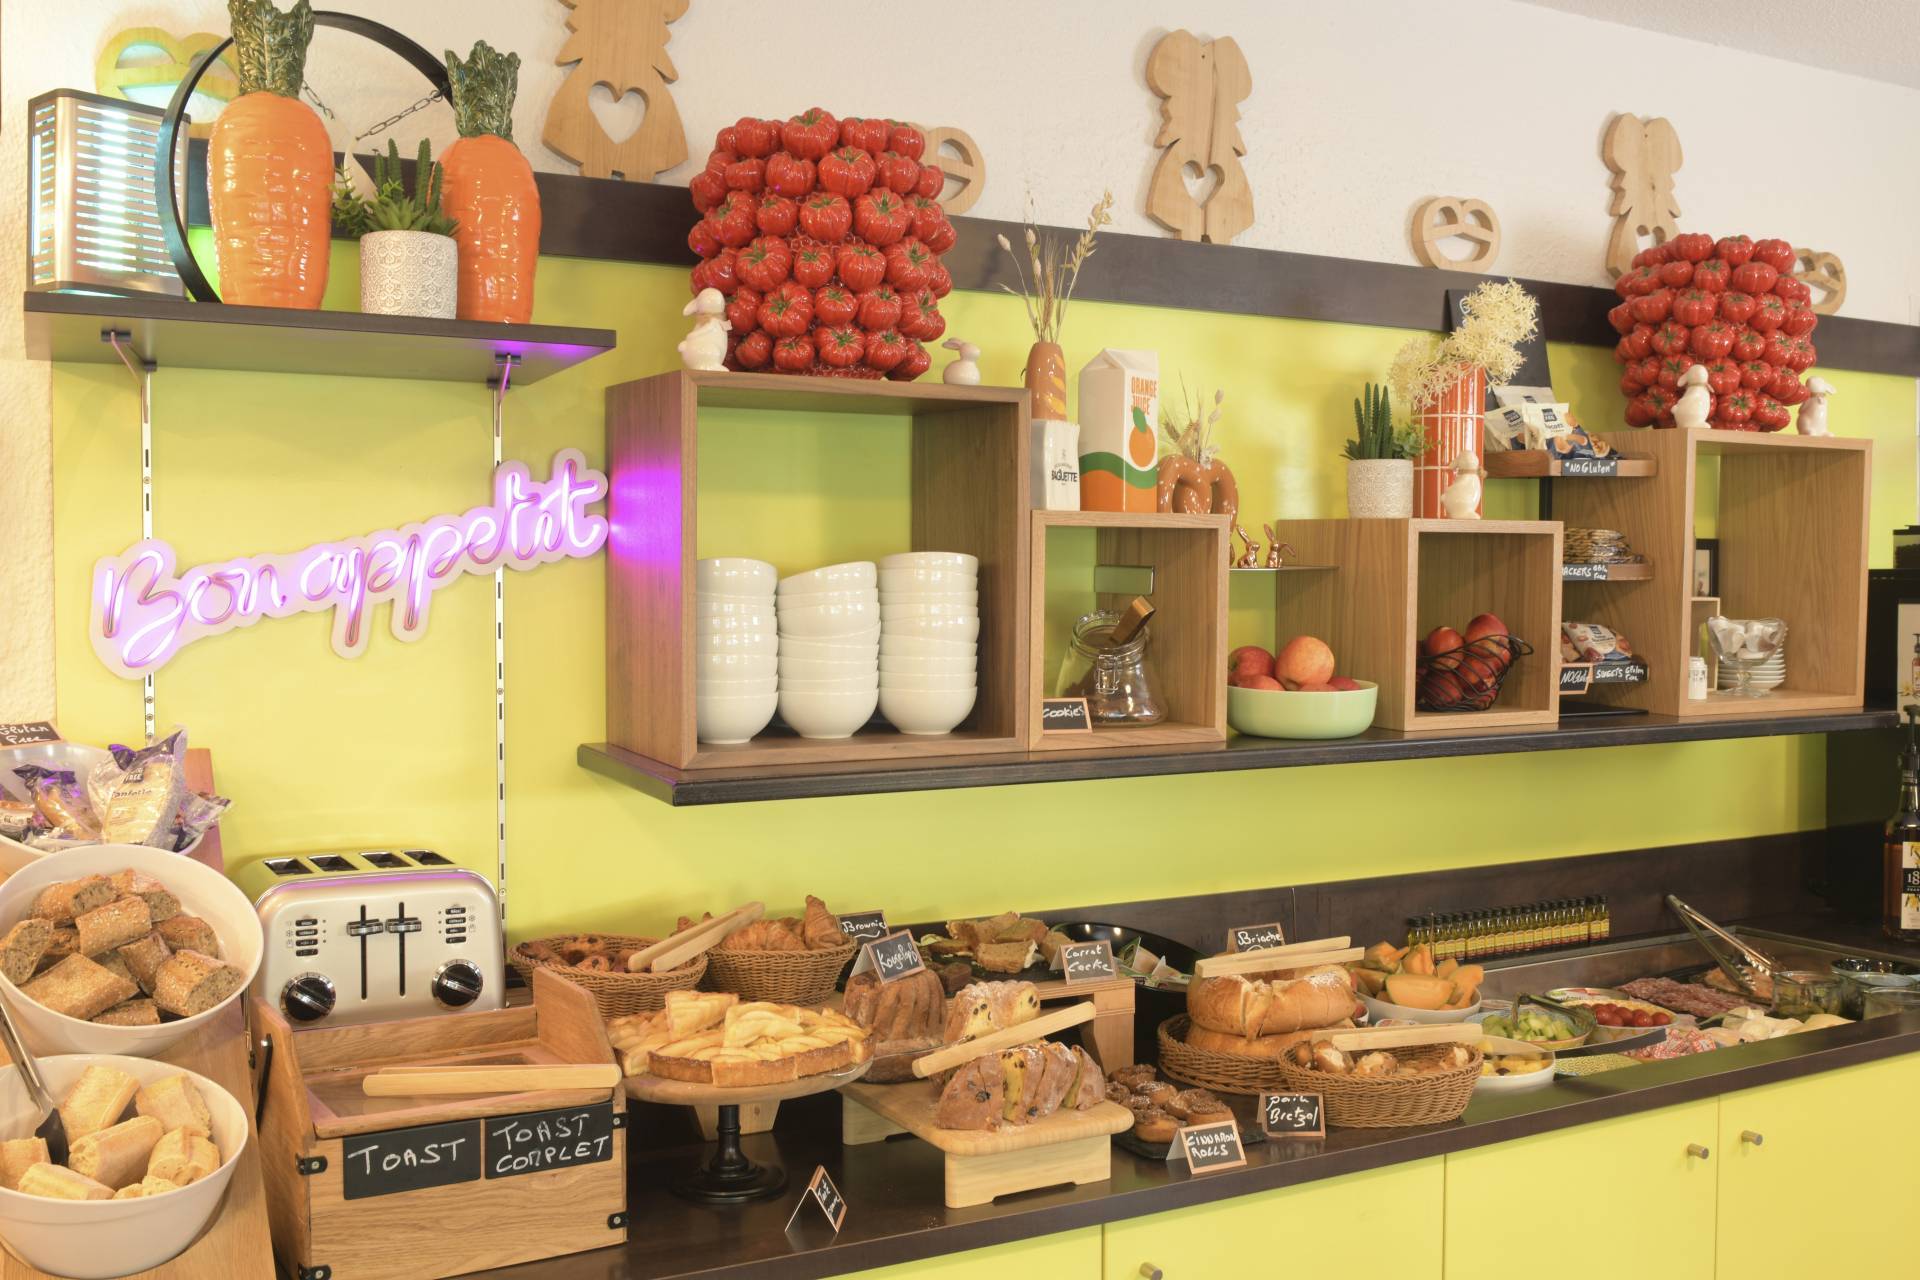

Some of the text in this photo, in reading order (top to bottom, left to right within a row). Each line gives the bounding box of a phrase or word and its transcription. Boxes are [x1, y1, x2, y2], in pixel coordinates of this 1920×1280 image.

[1131, 376, 1157, 399] ORANGE
[103, 457, 602, 668] Bon appetit
[1042, 704, 1084, 718] Cookies
[492, 1113, 590, 1151] TOAST
[348, 1138, 466, 1175] TOAST
[496, 1136, 610, 1173] COMPLET
[1191, 1144, 1229, 1158] ROLLS
